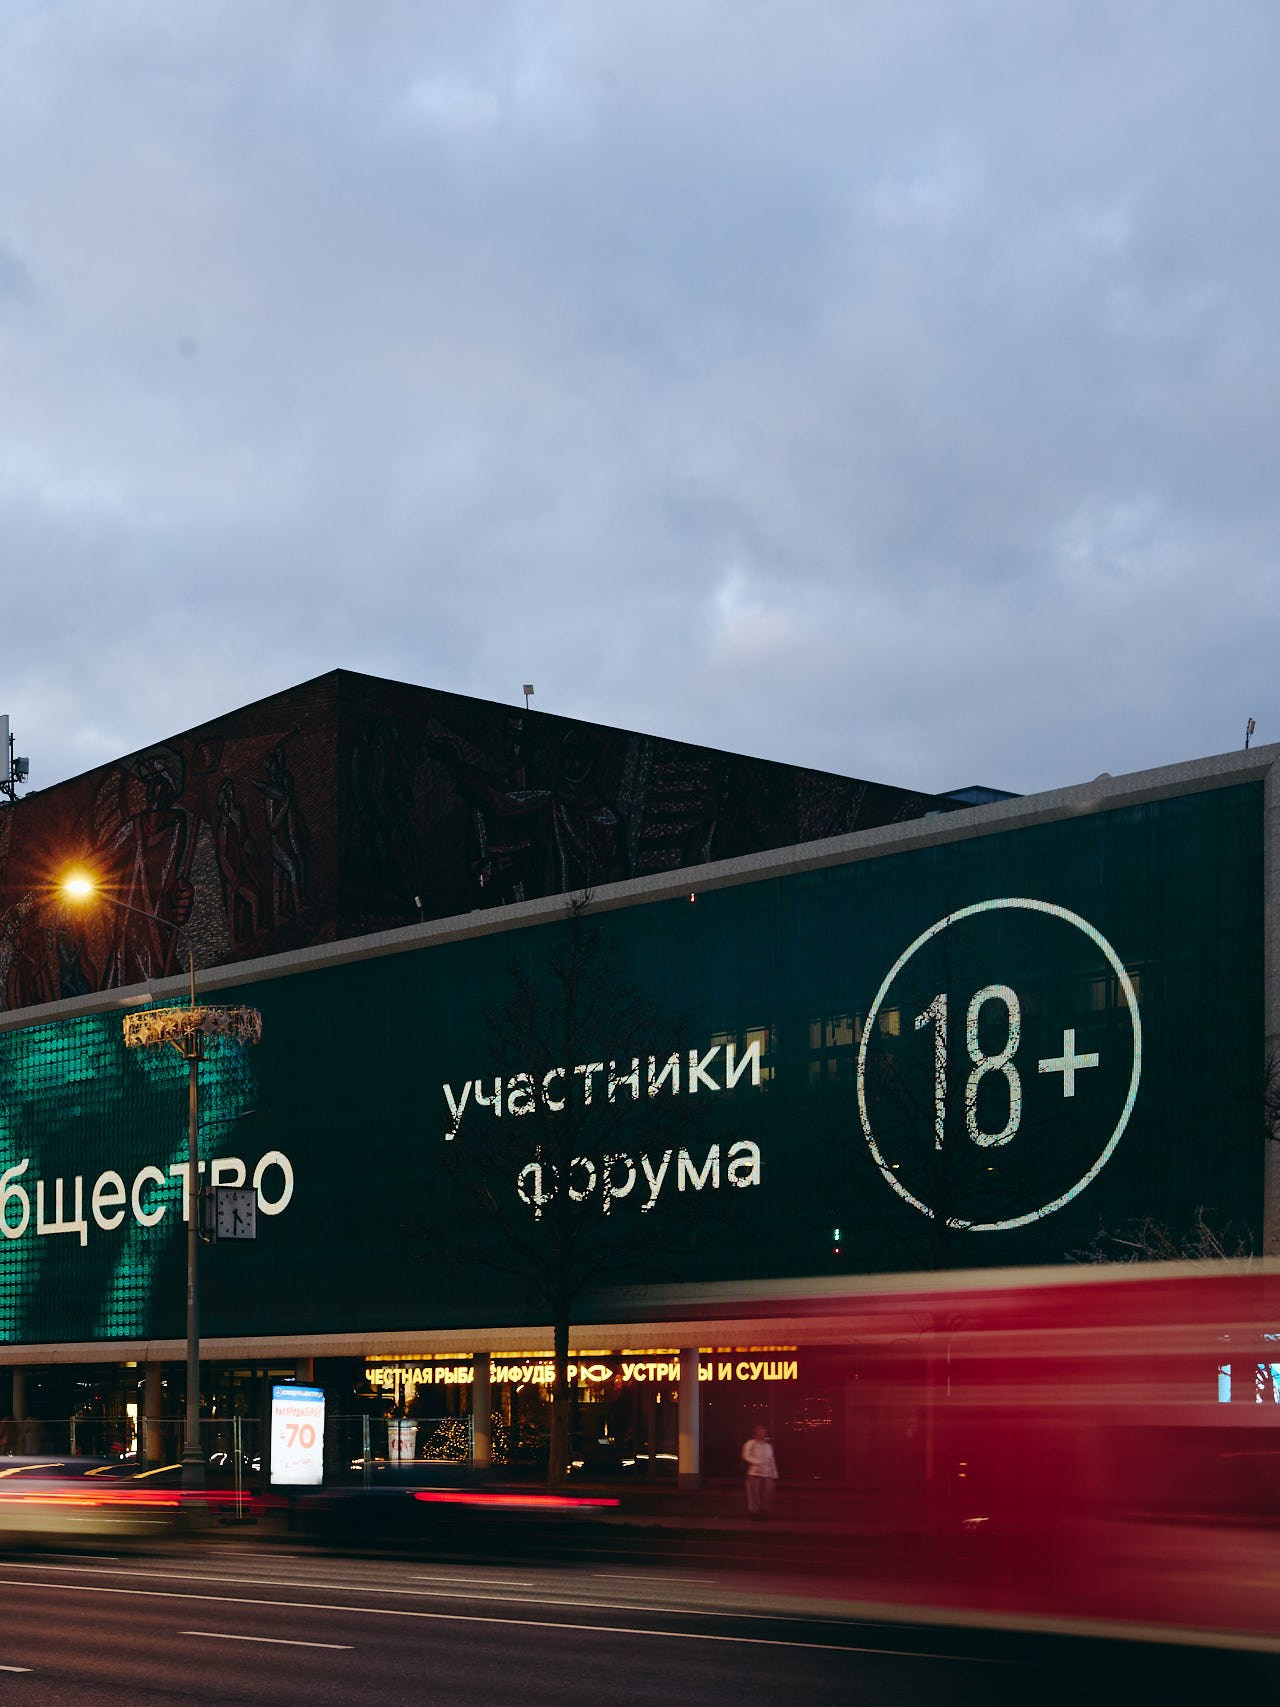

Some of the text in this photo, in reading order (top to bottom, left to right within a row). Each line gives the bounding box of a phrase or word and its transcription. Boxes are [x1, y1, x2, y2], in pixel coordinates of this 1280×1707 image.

[442, 1040, 761, 1141] участники
[915, 984, 1100, 1151] 18+
[517, 1140, 761, 1221] форума
[365, 1367, 433, 1385] ЧЕСТНАЯ
[489, 1364, 578, 1384] СИФУДБР
[621, 1361, 798, 1382] УСТРИЫ И СУШИ
[279, 1423, 316, 1449] -70
